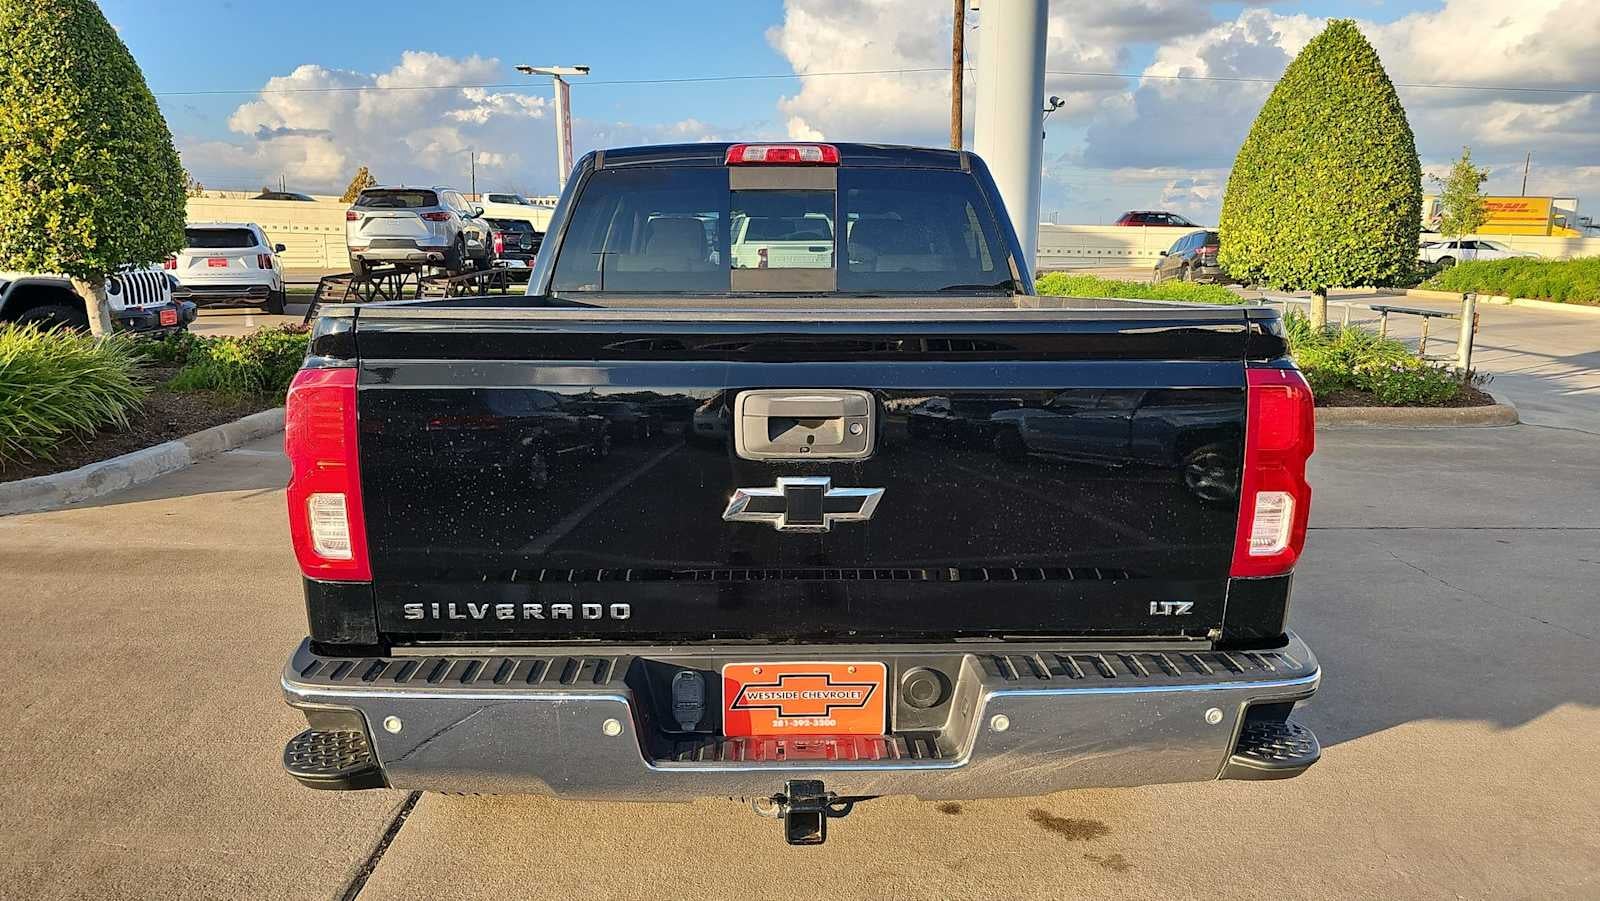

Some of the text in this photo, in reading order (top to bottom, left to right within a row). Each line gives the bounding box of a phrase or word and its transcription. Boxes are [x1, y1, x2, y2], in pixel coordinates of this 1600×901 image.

[403, 602, 631, 620] SILVERADO
[1149, 600, 1194, 615] LTZ
[746, 691, 862, 700] WESTSIDE CHEVROLET
